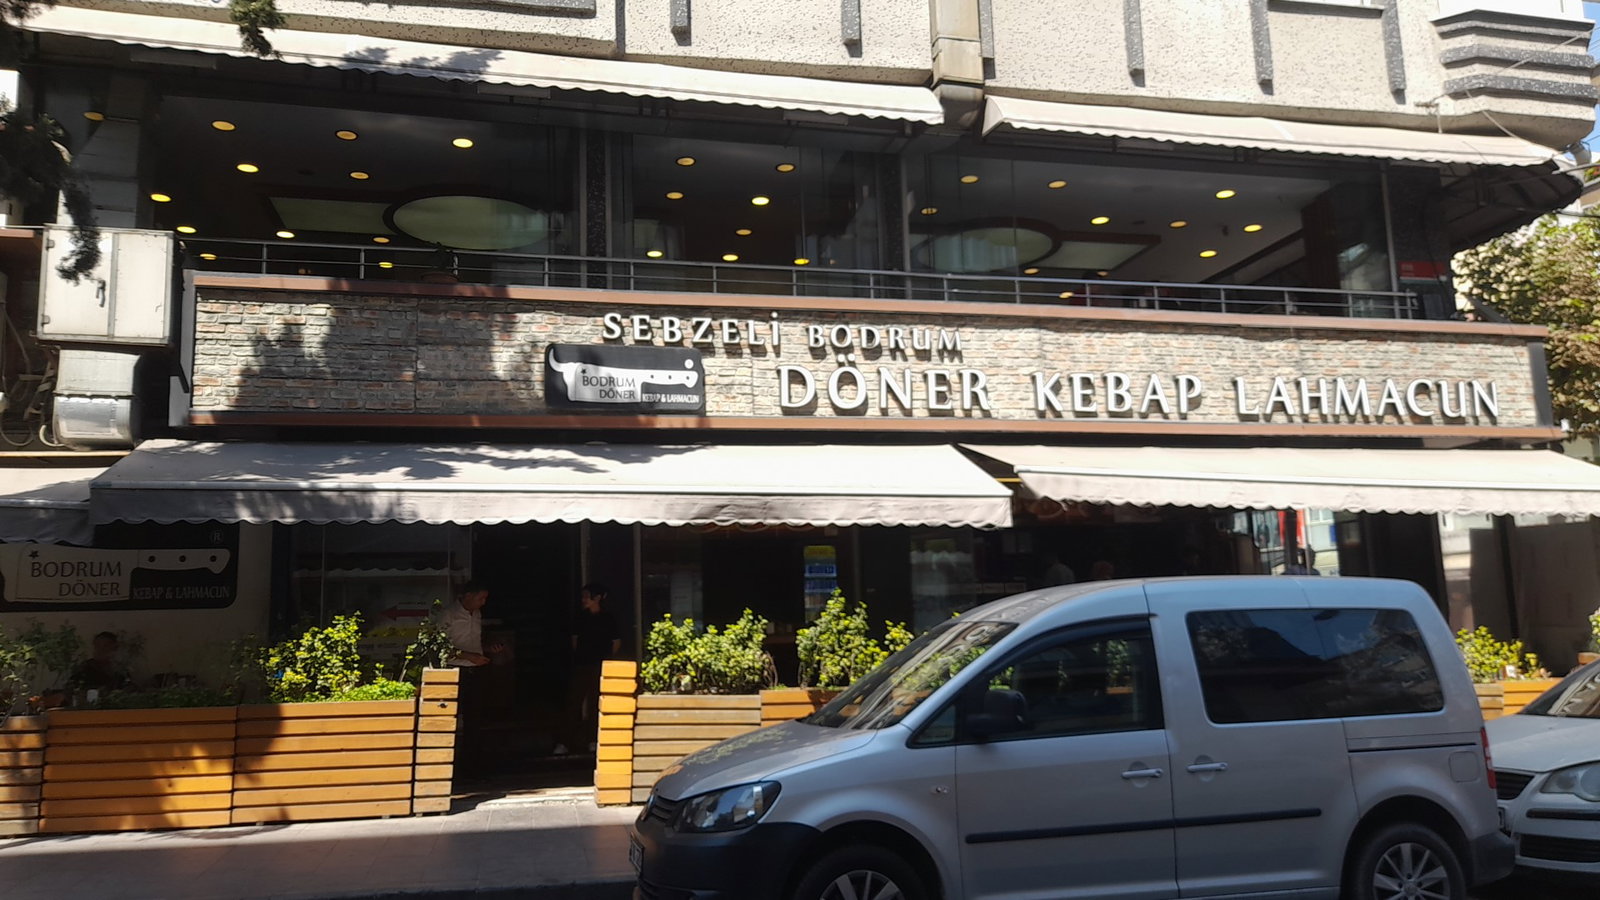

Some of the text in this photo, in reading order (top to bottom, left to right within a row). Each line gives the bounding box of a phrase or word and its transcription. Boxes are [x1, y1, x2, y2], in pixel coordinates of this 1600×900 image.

[602, 311, 962, 351] SEBZELİ BODRUM
[582, 375, 636, 388] BODRUM
[777, 353, 1499, 418] DÖNER KEBAP LAHMACUN
[599, 388, 636, 400] DÖNER
[642, 393, 661, 403] KEBAP
[666, 394, 700, 404] LAHMACUN
[30, 561, 122, 578] BODRUM
[58, 579, 121, 597] DÖNER
[132, 586, 164, 600] KEBAP
[175, 585, 230, 600] LAHMACUN
